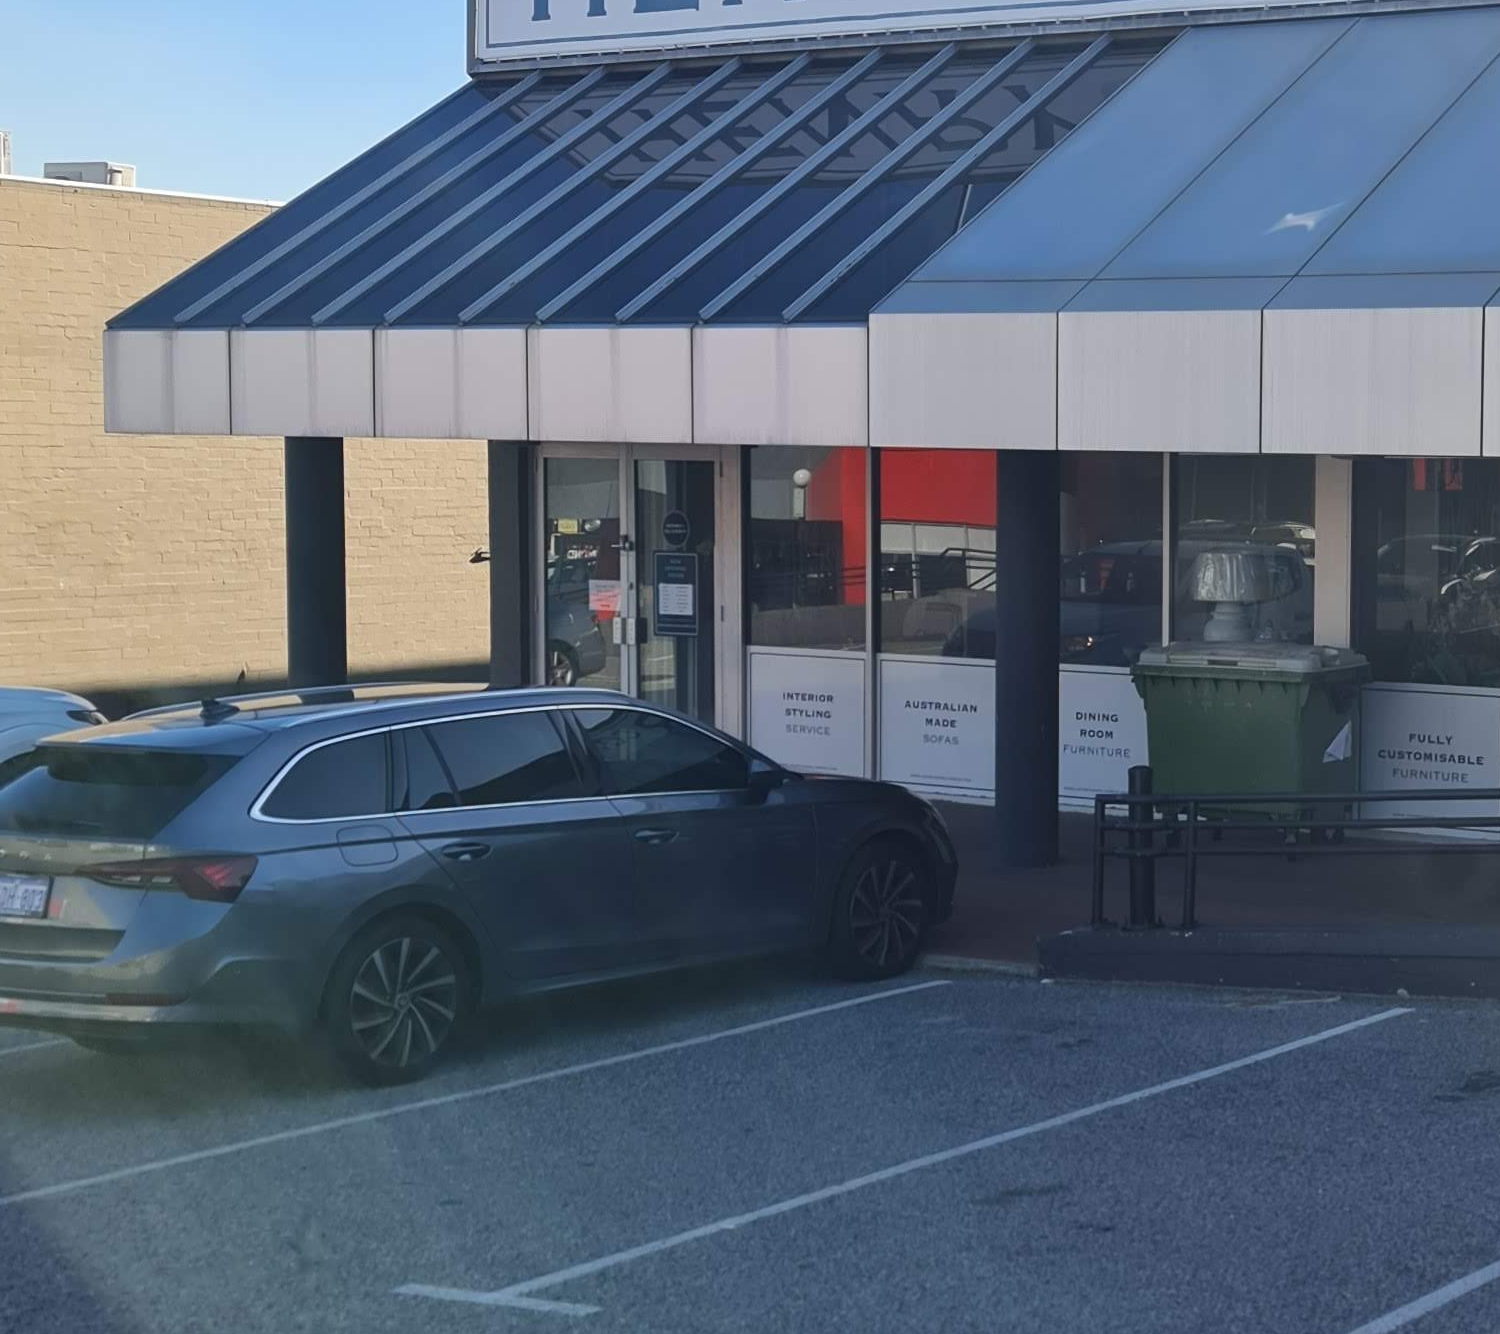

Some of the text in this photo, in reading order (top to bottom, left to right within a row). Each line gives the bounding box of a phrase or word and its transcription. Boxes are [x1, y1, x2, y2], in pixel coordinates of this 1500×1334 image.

[782, 692, 834, 703] INTERIOR
[904, 700, 978, 713] AUSTRALIAN
[785, 708, 832, 718] STYLING
[1075, 712, 1119, 722] DINING
[925, 718, 957, 728] MADE
[786, 724, 831, 735] SERVICE
[1079, 729, 1113, 739] ROOM
[923, 734, 959, 745] SOFAS
[1409, 733, 1453, 745] FULLY
[1063, 744, 1131, 758] FURNITURE
[1377, 749, 1485, 765] CUSTOMISABLE
[1392, 768, 1469, 783] FURNITURE
